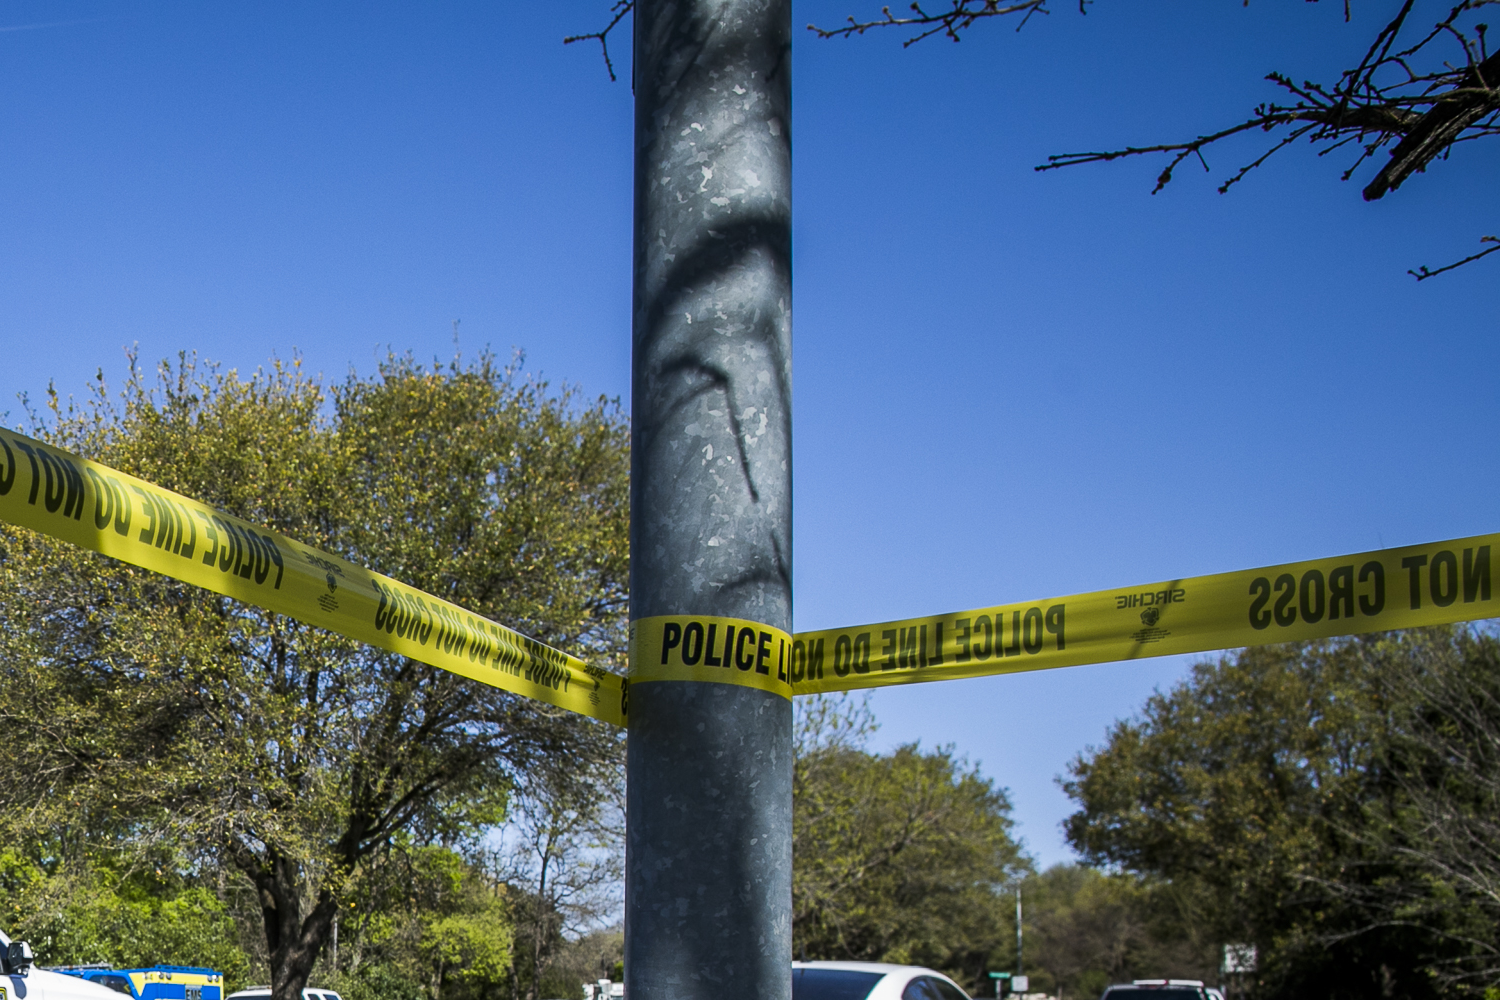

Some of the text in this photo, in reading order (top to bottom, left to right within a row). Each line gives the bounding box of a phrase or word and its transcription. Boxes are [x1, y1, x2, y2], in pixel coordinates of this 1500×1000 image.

[660, 621, 792, 687] POLICE LI
[185, 989, 202, 1000] EMS
